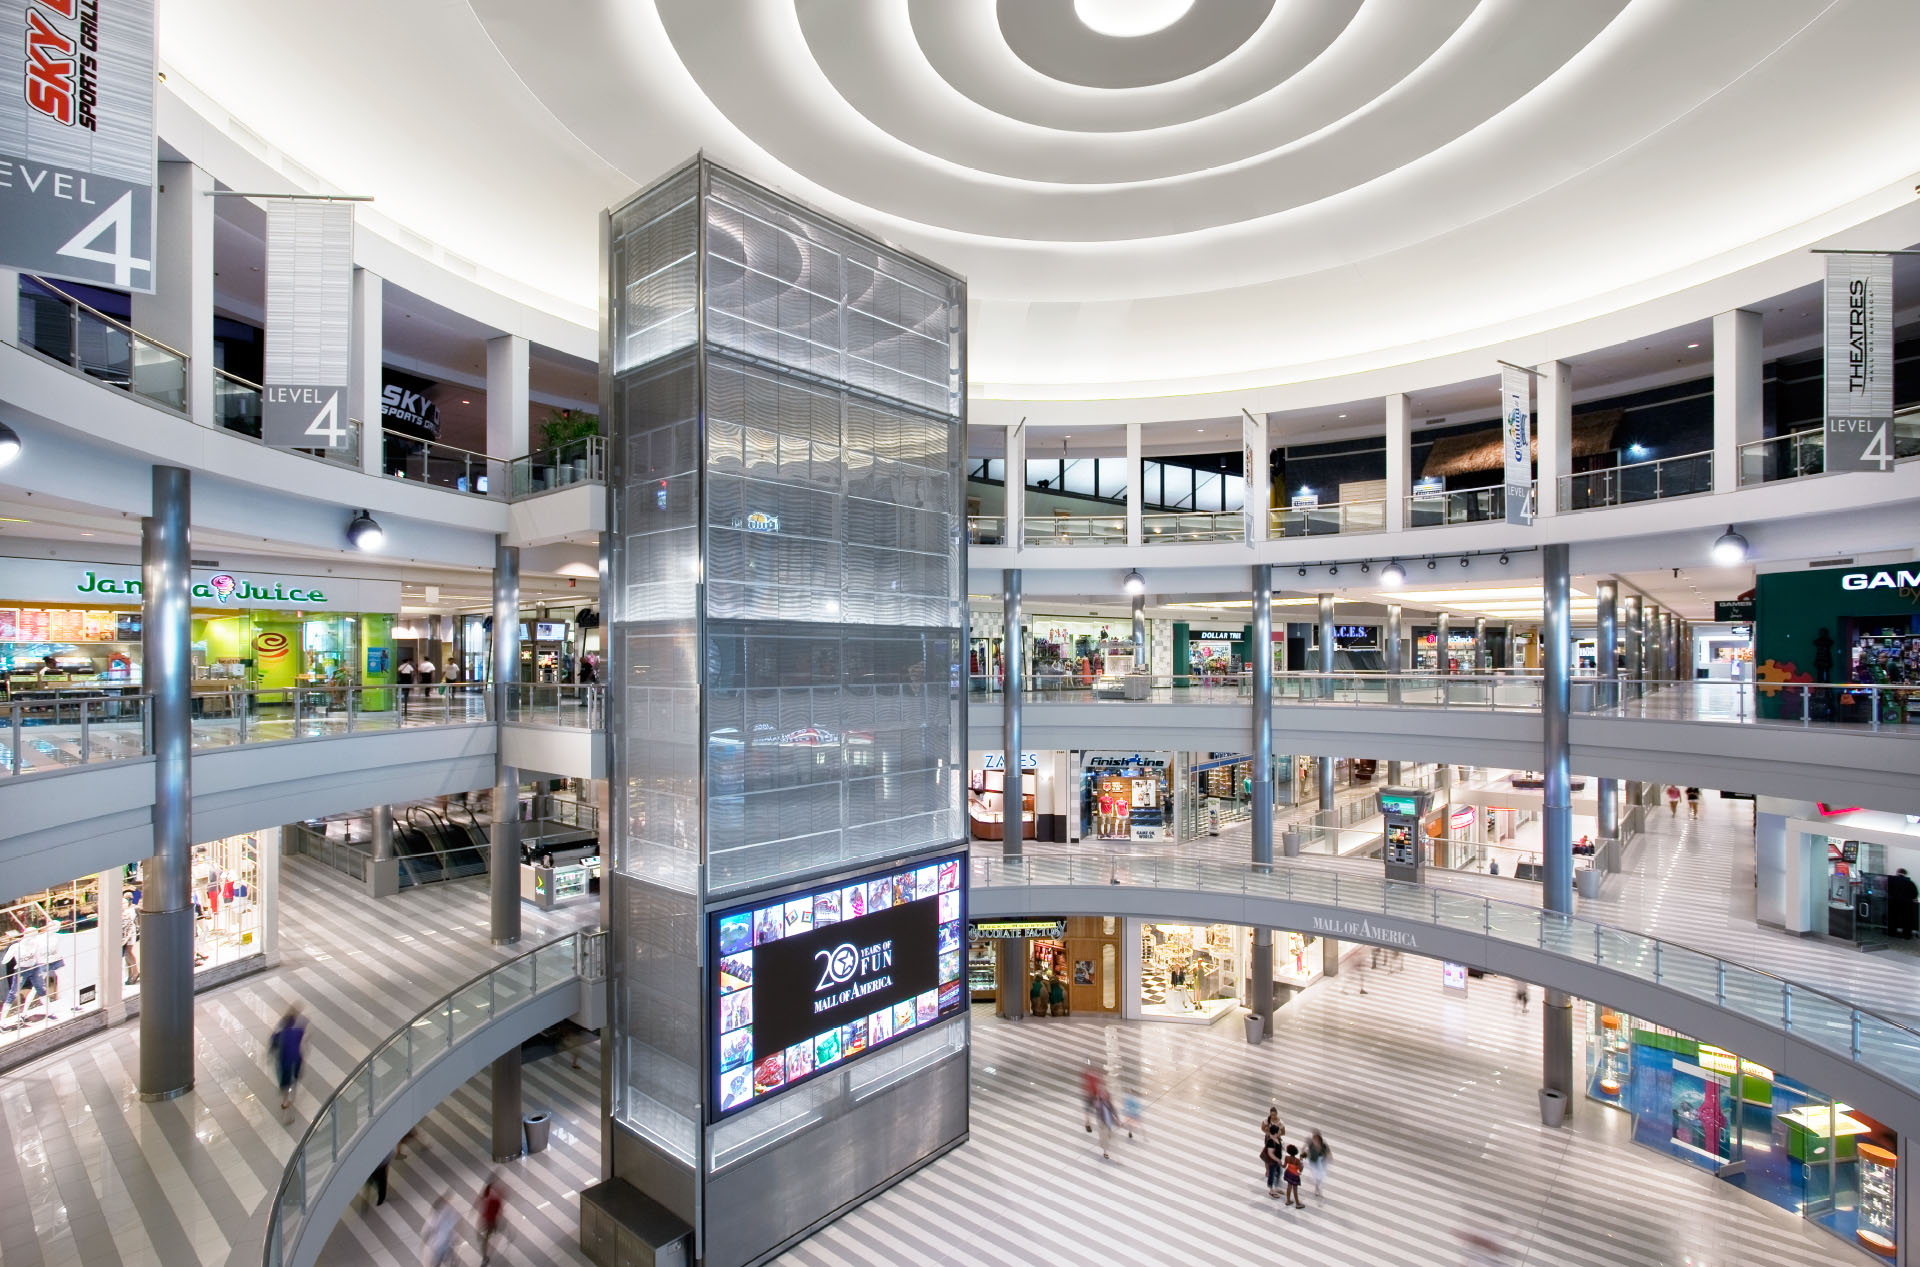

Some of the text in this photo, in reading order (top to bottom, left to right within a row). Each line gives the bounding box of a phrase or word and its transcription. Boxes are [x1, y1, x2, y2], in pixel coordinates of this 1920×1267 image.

[25, 7, 76, 126] SKY
[79, 53, 98, 132] SPORTS
[56, 190, 150, 287] 4
[1850, 279, 1863, 392] THEATRES
[269, 387, 322, 404] LEVEL
[382, 384, 432, 417] SKY
[304, 390, 346, 447] 4
[381, 404, 423, 426] SPORTS
[1831, 419, 1873, 432] LEVEL
[1859, 421, 1894, 471] 4
[1507, 487, 1525, 498] LEVEL
[1520, 490, 1532, 526] 4
[77, 571, 328, 602] Jaa Juice
[1201, 631, 1228, 639] DOLLAR
[1435, 635, 1473, 643] ioShack
[985, 753, 1037, 768] ZAES
[1313, 917, 1418, 947] MALL OF AMERICA
[860, 940, 892, 957] YEARS OF
[860, 949, 892, 976] FUN
[814, 943, 859, 992] 20
[813, 994, 839, 1014] MALL
[838, 989, 852, 1004] OF
